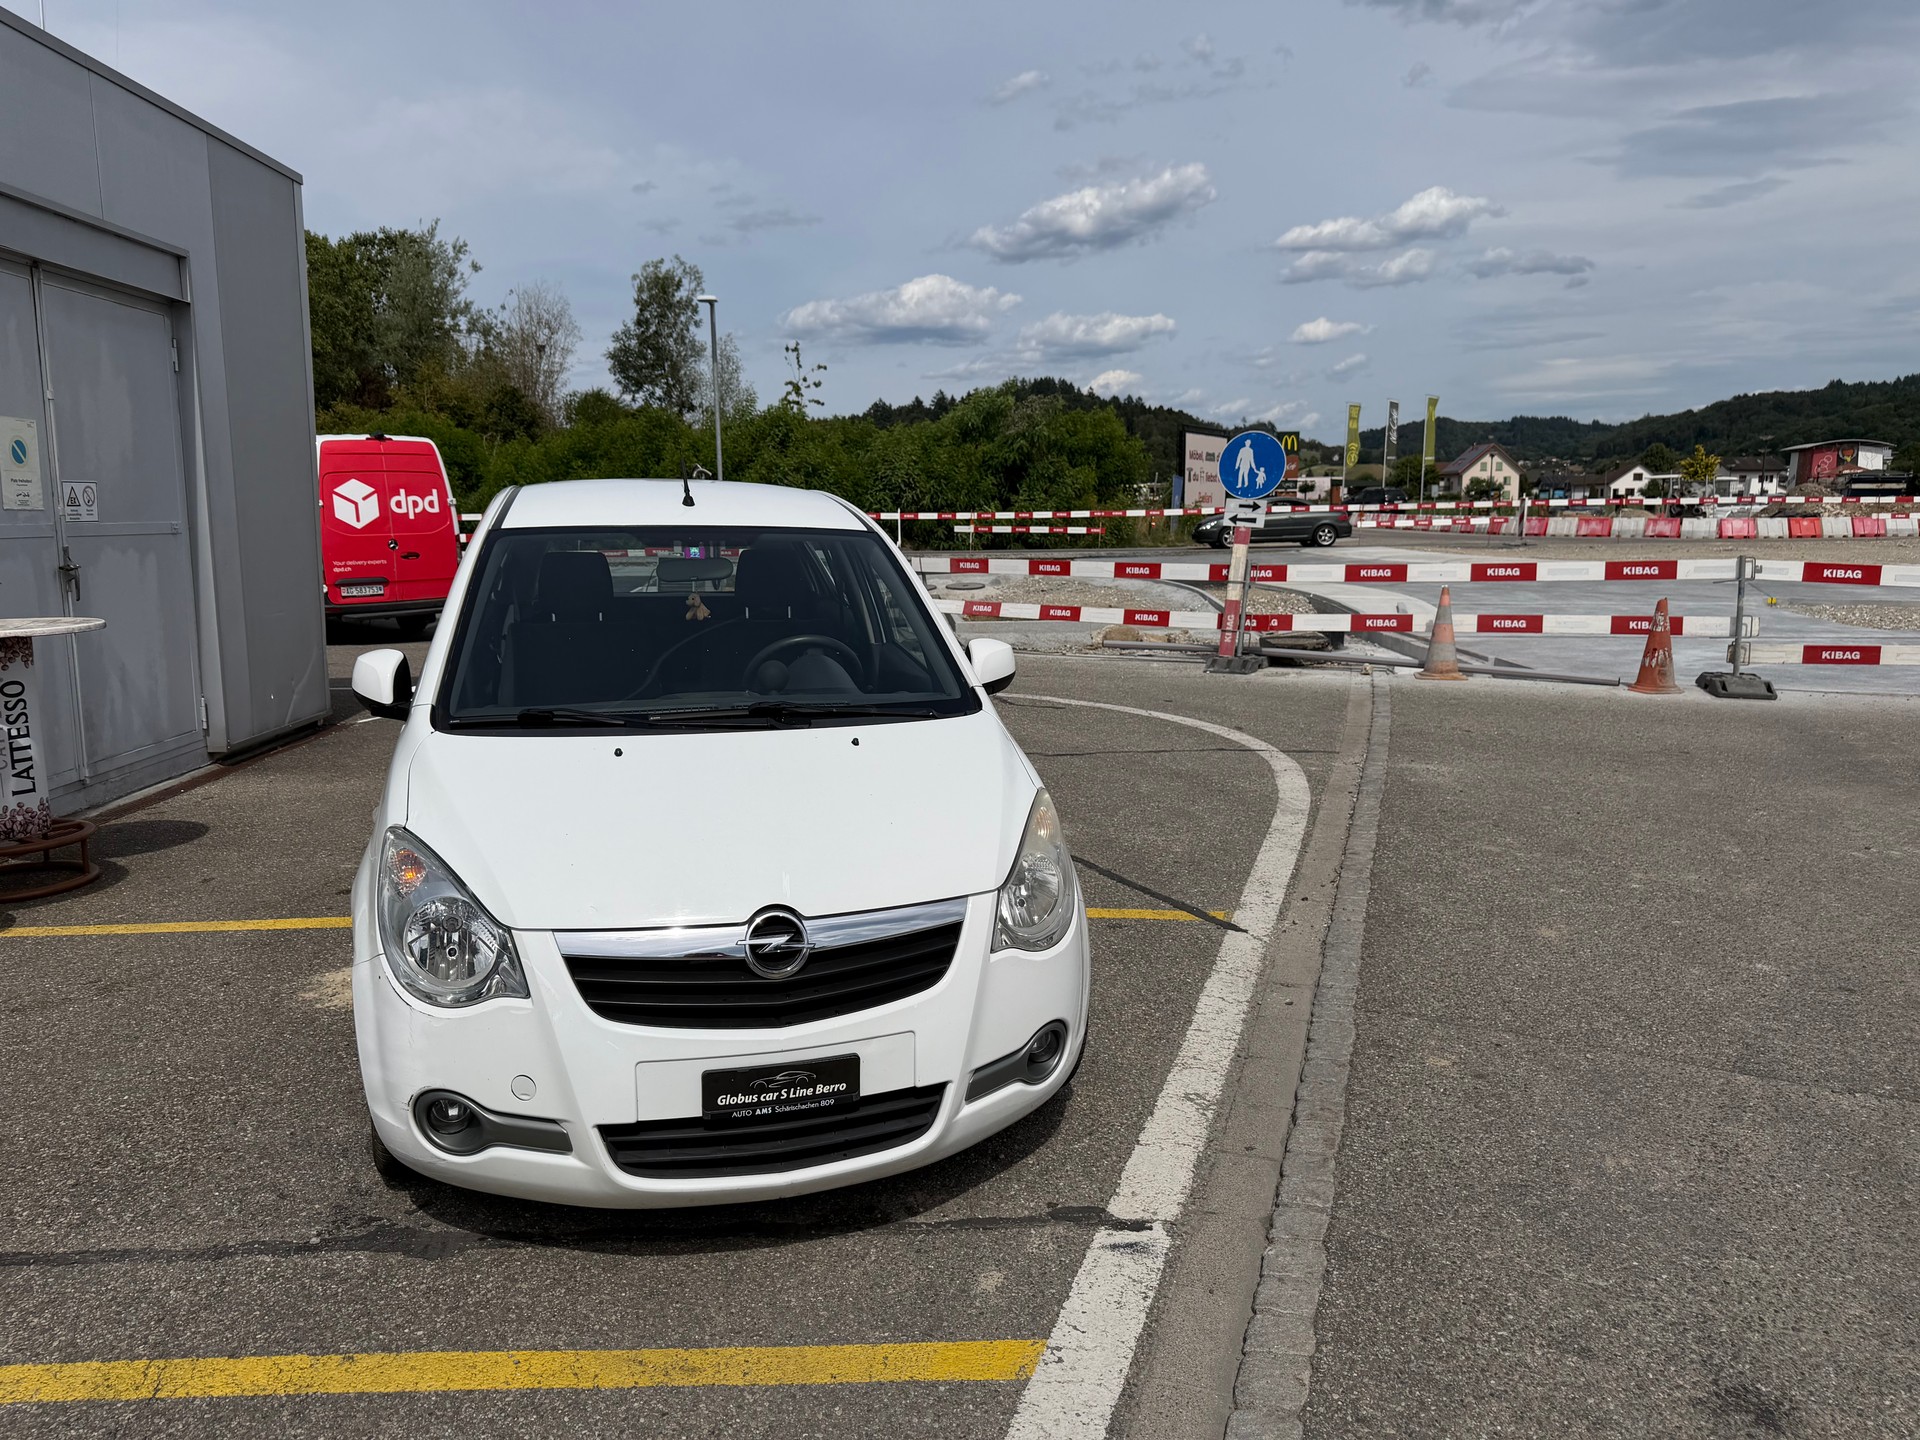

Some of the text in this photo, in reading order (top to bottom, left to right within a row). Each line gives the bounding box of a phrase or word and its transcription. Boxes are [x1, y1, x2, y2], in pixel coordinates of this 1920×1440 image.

[389, 488, 440, 520] dpd
[959, 562, 980, 570] KIBAG
[1038, 564, 1061, 572] KIBAG
[1125, 566, 1150, 575] KIBAG
[1623, 566, 1659, 575] KIBAG
[1360, 569, 1392, 577] KIBAG
[1487, 568, 1520, 576] KIBAG
[1823, 569, 1862, 578] KIBAG
[972, 604, 993, 612] KIBAG
[1049, 608, 1072, 617] KIBAG
[1134, 613, 1159, 622] KIBAG
[1366, 619, 1397, 627] KIBAG
[1493, 620, 1527, 628] KIBAG
[1629, 621, 1651, 630] KIB
[1822, 651, 1860, 659] KIBAG
[0, 680, 37, 797] LATTESSO
[717, 1082, 847, 1106] Globus car S Line Berro
[732, 1109, 752, 1118] AUTO
[755, 1106, 772, 1115] AMS
[820, 1098, 835, 1107] 809
